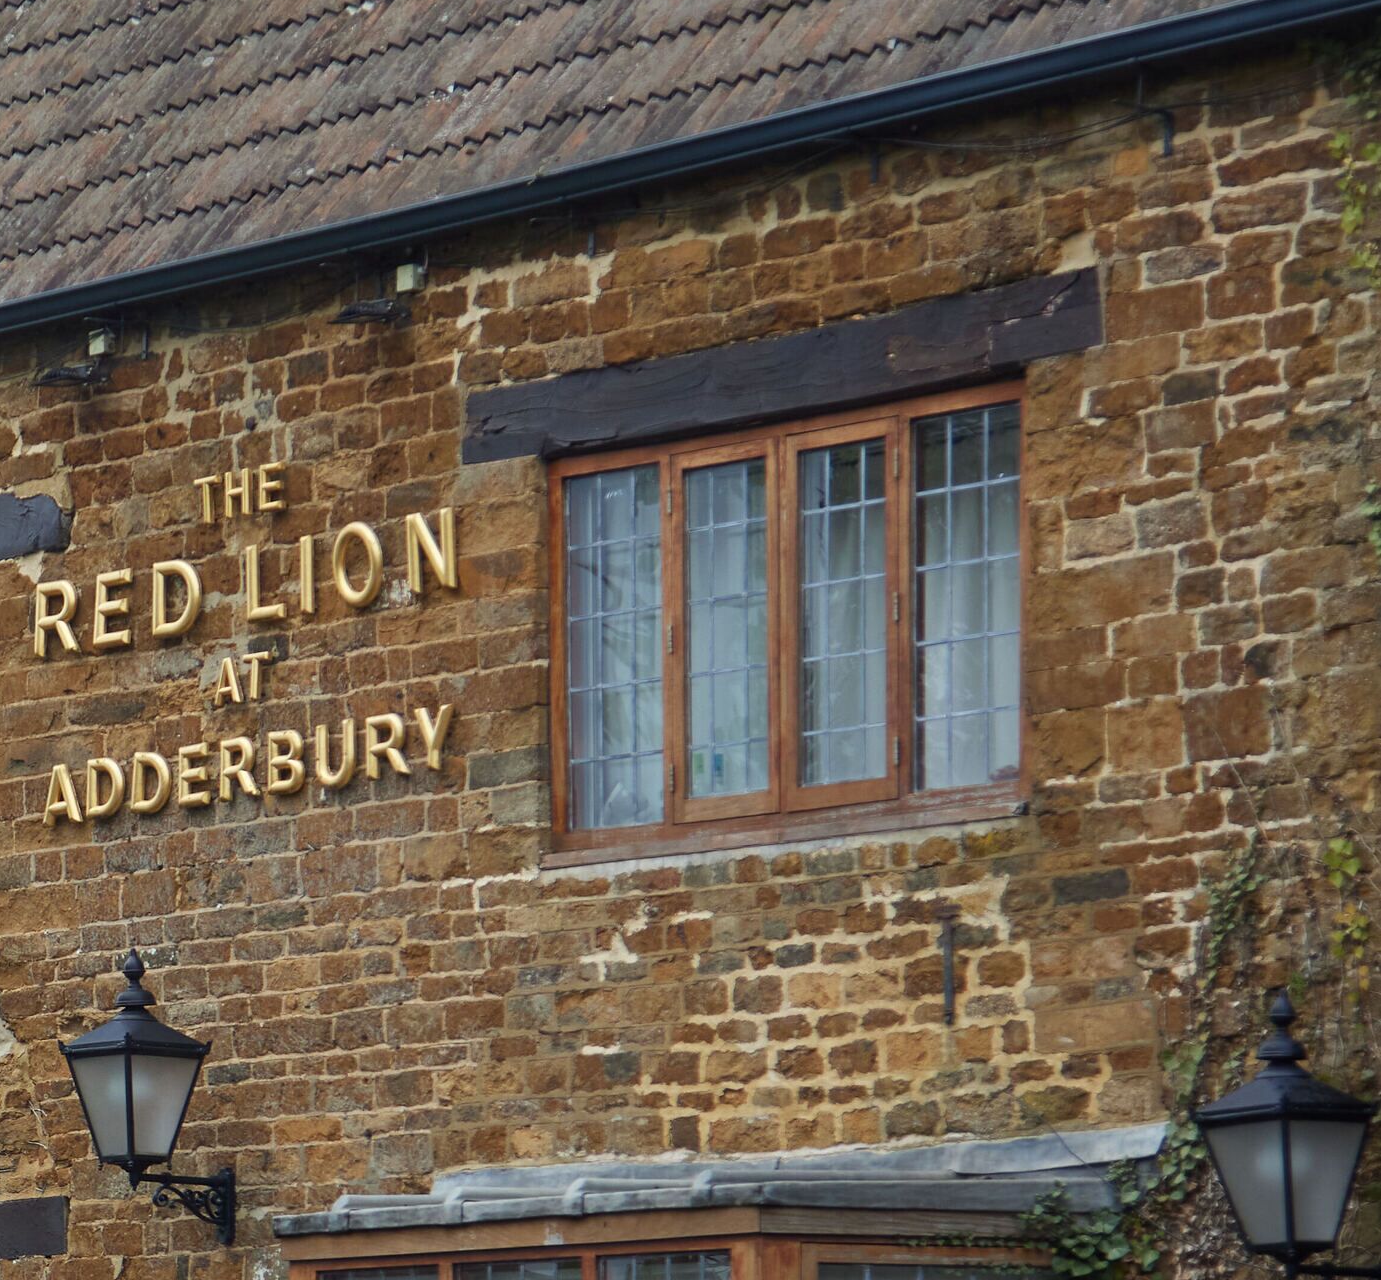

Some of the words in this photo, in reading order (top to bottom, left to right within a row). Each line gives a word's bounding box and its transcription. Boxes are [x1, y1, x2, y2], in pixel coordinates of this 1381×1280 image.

[193, 461, 288, 523] THE
[33, 558, 202, 657] RED
[245, 506, 459, 620] LION
[214, 651, 272, 707] AT
[42, 703, 454, 825] ADDERBURY
